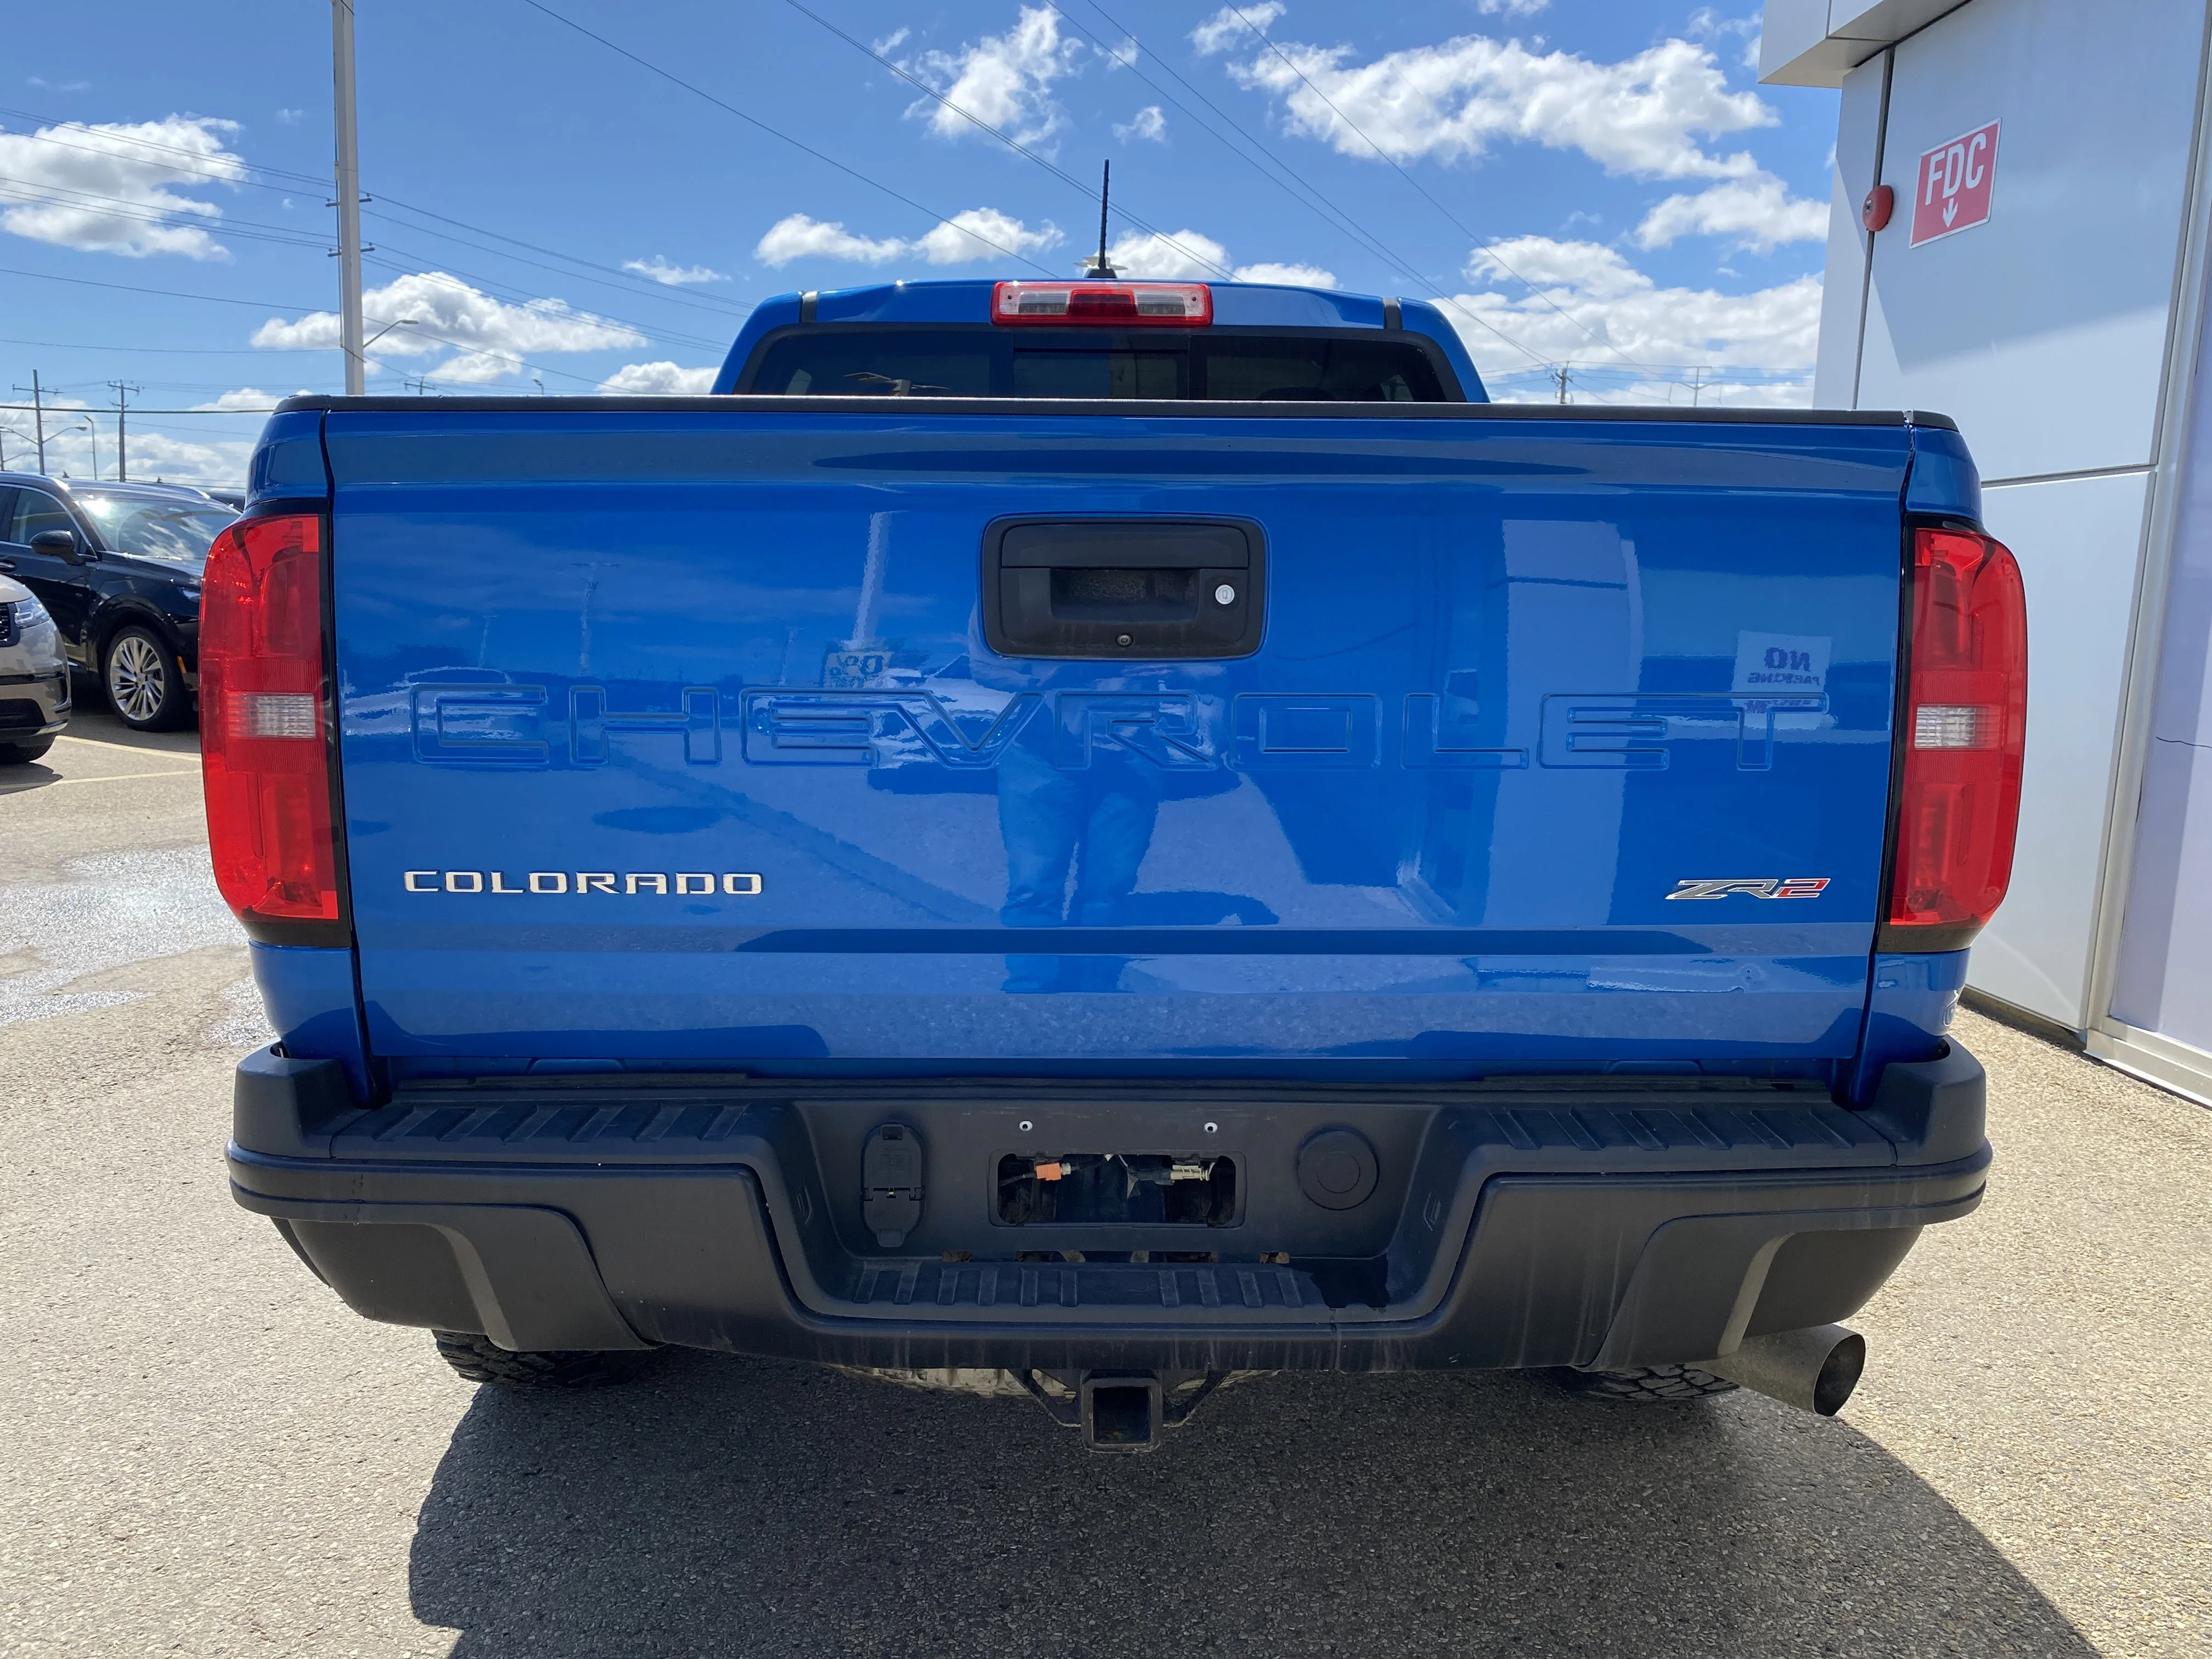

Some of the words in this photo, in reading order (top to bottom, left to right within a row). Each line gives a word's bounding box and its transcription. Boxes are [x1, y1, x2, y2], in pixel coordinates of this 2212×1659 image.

[1925, 132, 1987, 206] FDC
[409, 684, 1829, 771] CHEVROLET
[404, 870, 763, 895] COLORADO
[1664, 878, 1831, 900] ZR2
